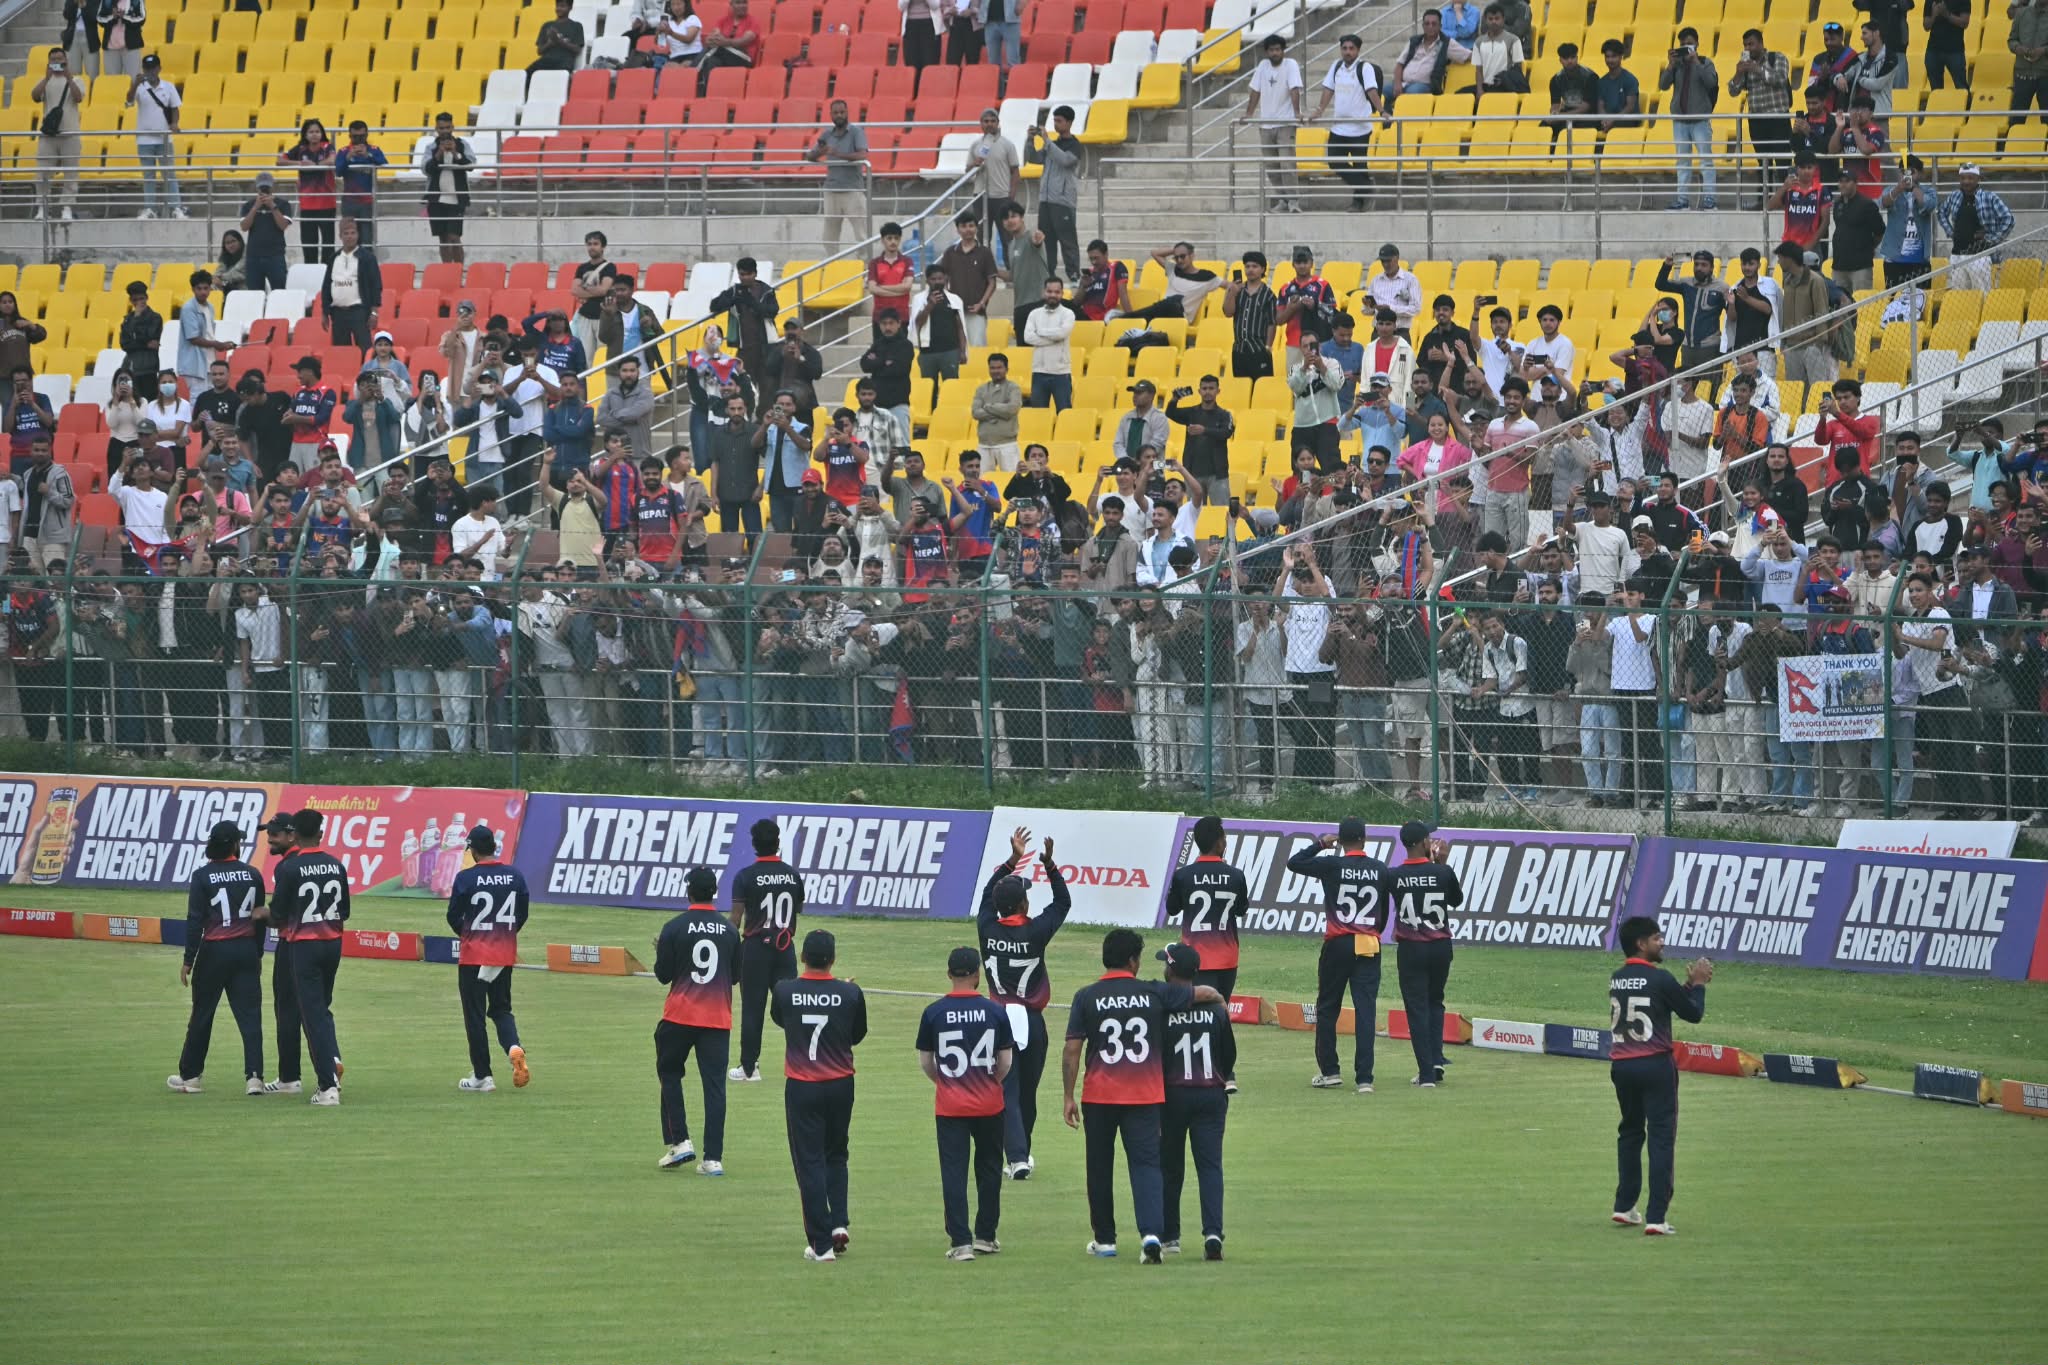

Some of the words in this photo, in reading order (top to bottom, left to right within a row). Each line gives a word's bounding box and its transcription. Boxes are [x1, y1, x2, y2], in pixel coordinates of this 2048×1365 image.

[1788, 204, 1817, 214] NEPAL
[638, 509, 668, 520] NEPAL
[1824, 659, 1855, 669] THANK
[1857, 658, 1877, 668] YOU
[87, 786, 171, 840] MAX
[172, 790, 265, 844] TIGER
[555, 806, 739, 866] XTREME
[775, 814, 951, 875] XTREME
[76, 839, 174, 882] ENERGY
[209, 870, 255, 885] BHURTEL
[300, 864, 341, 877] NANDAN
[1031, 863, 1151, 889] HONDA
[1341, 868, 1379, 881] ISHAN
[476, 875, 514, 887] AARIF
[548, 862, 645, 897] ENERGY
[756, 874, 797, 886] SOMPAL
[855, 875, 936, 909] DRINK
[1193, 874, 1231, 886] LALIT
[1396, 875, 1438, 888] AIREE
[1507, 847, 1626, 918] BAM!
[1660, 851, 1827, 919] XTREME
[11, 910, 24, 921] T10
[26, 910, 56, 921] SPORTS
[210, 887, 257, 927] 14
[298, 879, 342, 924] 22
[470, 891, 517, 932] 24
[760, 891, 793, 929] 10
[1188, 890, 1238, 933] 27
[1336, 883, 1380, 926] 52
[1399, 892, 1445, 932] 45
[1845, 864, 2016, 933] XTREME
[109, 917, 122, 928] MAX
[123, 918, 139, 929] TIGER
[688, 922, 727, 935] AASIF
[1531, 922, 1607, 948] DRINK
[1656, 912, 1739, 950] ENERGY
[1737, 918, 1809, 956] DRINK
[690, 938, 719, 984] 9
[986, 938, 1030, 954] ROHIT
[1835, 926, 1927, 965] ENERGY
[1925, 932, 1999, 971] DRINK
[984, 955, 1041, 998] 17
[1609, 977, 1648, 990] ANDEEP
[791, 993, 842, 1007] BINOD
[946, 1009, 987, 1024] BHIM
[1096, 994, 1151, 1012] KARAN
[1168, 1010, 1214, 1027] ARJUN
[1572, 1027, 1600, 1043] XTREME
[1610, 995, 1654, 1042] 25
[801, 1014, 829, 1061] 7
[938, 1028, 996, 1078] 54
[1099, 1016, 1150, 1064] 33
[1494, 1031, 1536, 1046] HONDA
[1174, 1032, 1213, 1080] 11
